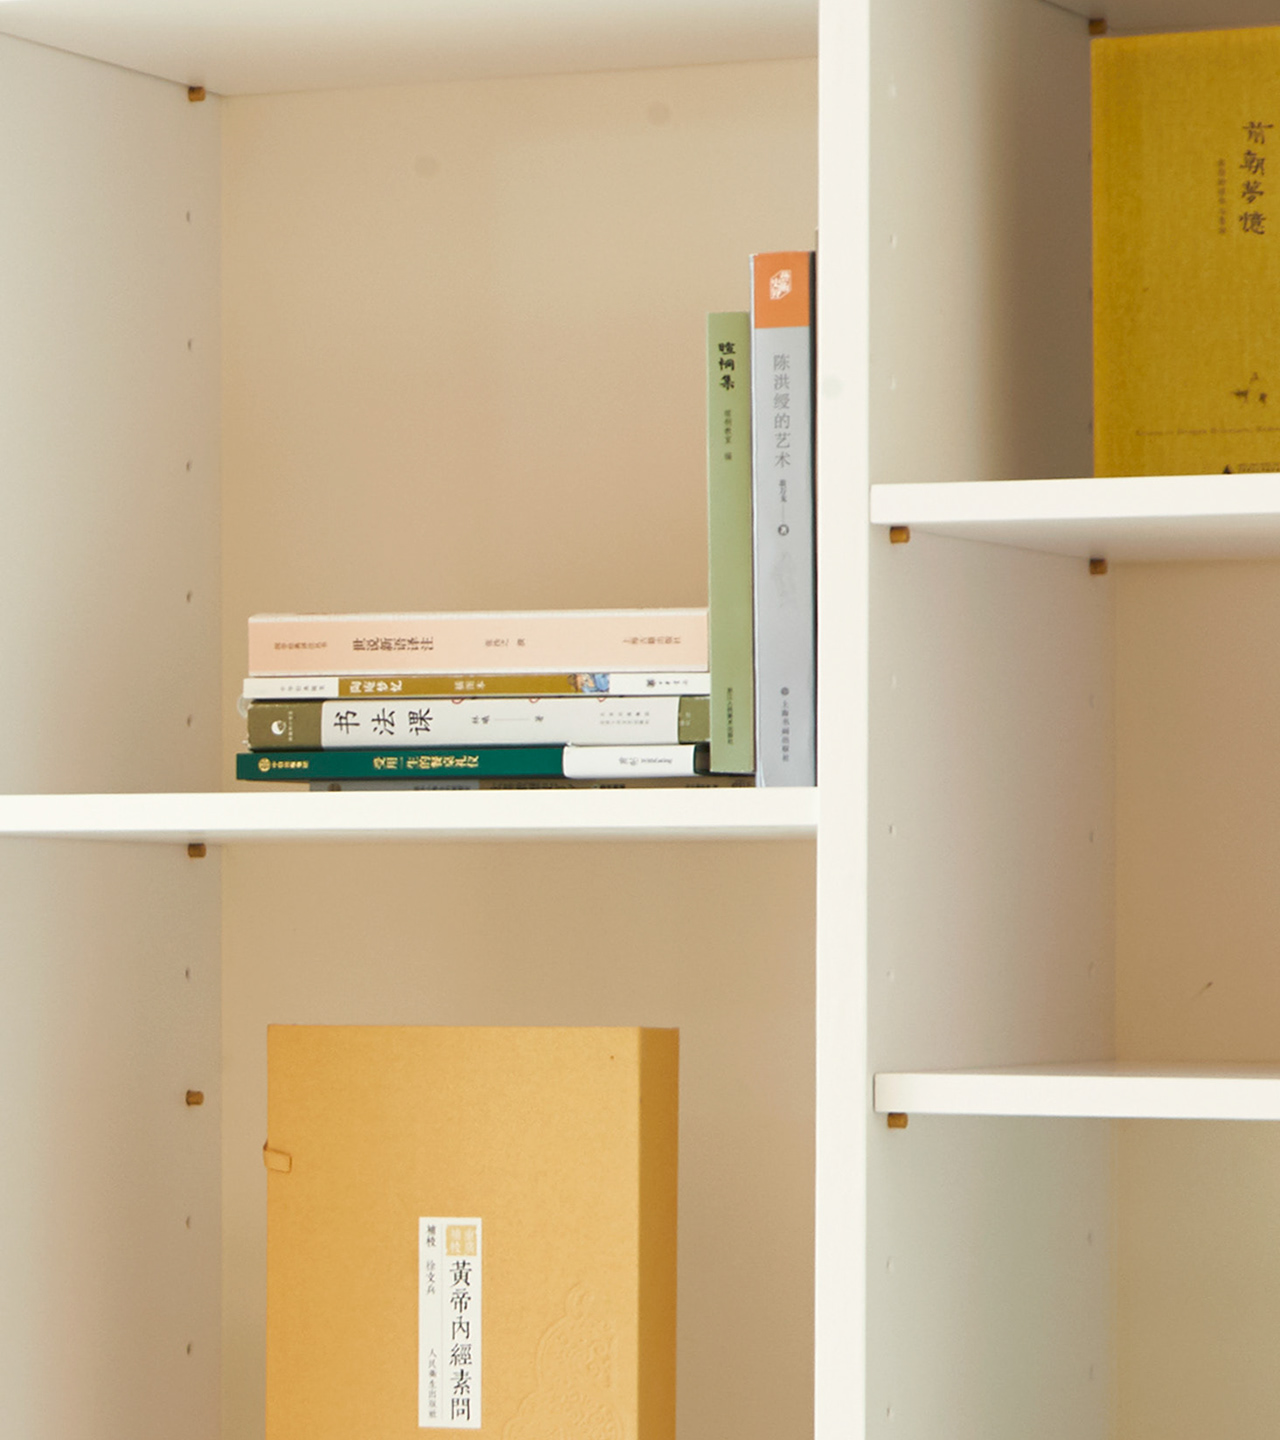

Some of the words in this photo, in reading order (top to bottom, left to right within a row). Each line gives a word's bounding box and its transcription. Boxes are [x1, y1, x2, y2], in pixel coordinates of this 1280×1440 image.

[1239, 121, 1274, 235] 前朝夢憶
[773, 354, 791, 468] 陈洪绶的艺术
[352, 636, 434, 652] 世说新语译注
[349, 679, 403, 694] 陶庵梦忆
[334, 707, 434, 736] 书法课
[373, 755, 480, 770] 受用一生的餐桌礼仪
[426, 1260, 436, 1295] 徐文兵
[449, 1260, 473, 1422] 黃帝內經素問
